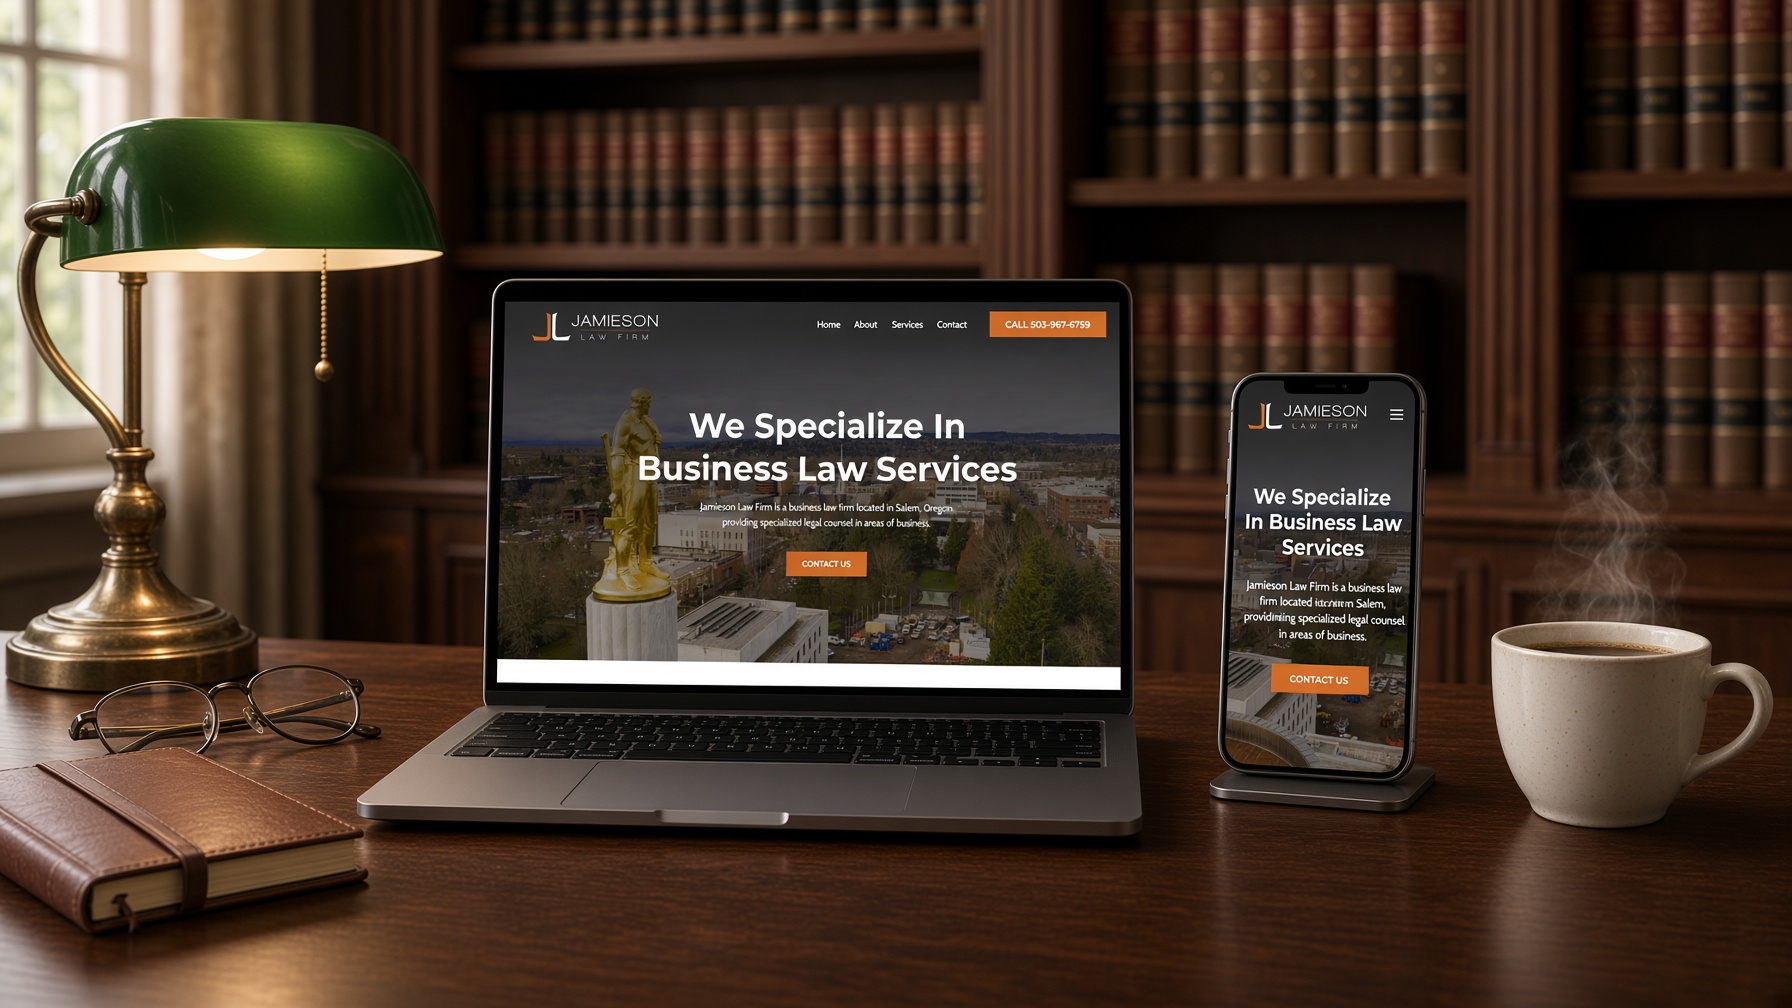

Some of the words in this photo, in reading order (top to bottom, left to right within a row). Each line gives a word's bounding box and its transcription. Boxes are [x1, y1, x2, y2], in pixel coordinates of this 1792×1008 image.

[571, 314, 659, 327] JAMIESON
[816, 320, 841, 329] Home
[853, 320, 878, 329] About
[891, 320, 924, 329] Services
[936, 320, 968, 329] Contact
[1005, 320, 1029, 329] CALL
[1030, 320, 1091, 329] 503-967-6759
[1283, 404, 1367, 418] JAMIESON
[689, 412, 745, 439] We
[754, 410, 924, 445] Specialize
[934, 413, 965, 439] In
[1291, 422, 1318, 430] LAW
[638, 453, 788, 482] Business
[799, 455, 868, 482] Law
[876, 454, 1018, 483] Services
[1253, 487, 1287, 505] We
[1291, 487, 1391, 510] Specialize
[699, 502, 736, 512] Jamieson
[737, 503, 754, 511] Law
[755, 502, 773, 511] Firm
[788, 502, 822, 512] business
[823, 503, 837, 512] law
[838, 503, 855, 512] firm
[856, 503, 885, 512] located
[886, 504, 894, 512] in
[895, 503, 922, 513] Salem,
[923, 504, 954, 515] Oregon
[722, 518, 759, 529] providing
[760, 518, 802, 529] specialized
[803, 518, 822, 529] legal
[823, 518, 853, 527] counsel
[855, 519, 863, 527] in
[886, 519, 896, 527] of
[1245, 513, 1263, 530] In
[1269, 512, 1357, 531] Business
[1362, 514, 1403, 532] Law
[1282, 538, 1365, 557] Services
[801, 560, 839, 568] CONTACT
[840, 560, 852, 568] US
[1246, 580, 1288, 592] Jamieson
[1289, 581, 1307, 591] Law
[1309, 581, 1330, 592] Firm
[1331, 581, 1339, 592] is
[1340, 584, 1346, 592] a
[1348, 581, 1385, 593] business
[1387, 582, 1402, 593] law
[1259, 595, 1278, 606] firm
[1280, 596, 1313, 607] located
[1356, 597, 1386, 610] Salem,
[1297, 613, 1346, 626] specialized
[1348, 613, 1369, 627] legal
[1370, 615, 1405, 626] counsel
[1278, 628, 1288, 639] in
[1289, 631, 1313, 640] areas
[1315, 629, 1325, 640] of
[1327, 629, 1367, 642] business.
[1289, 674, 1334, 684] CONTACT
[1335, 676, 1349, 685] US
